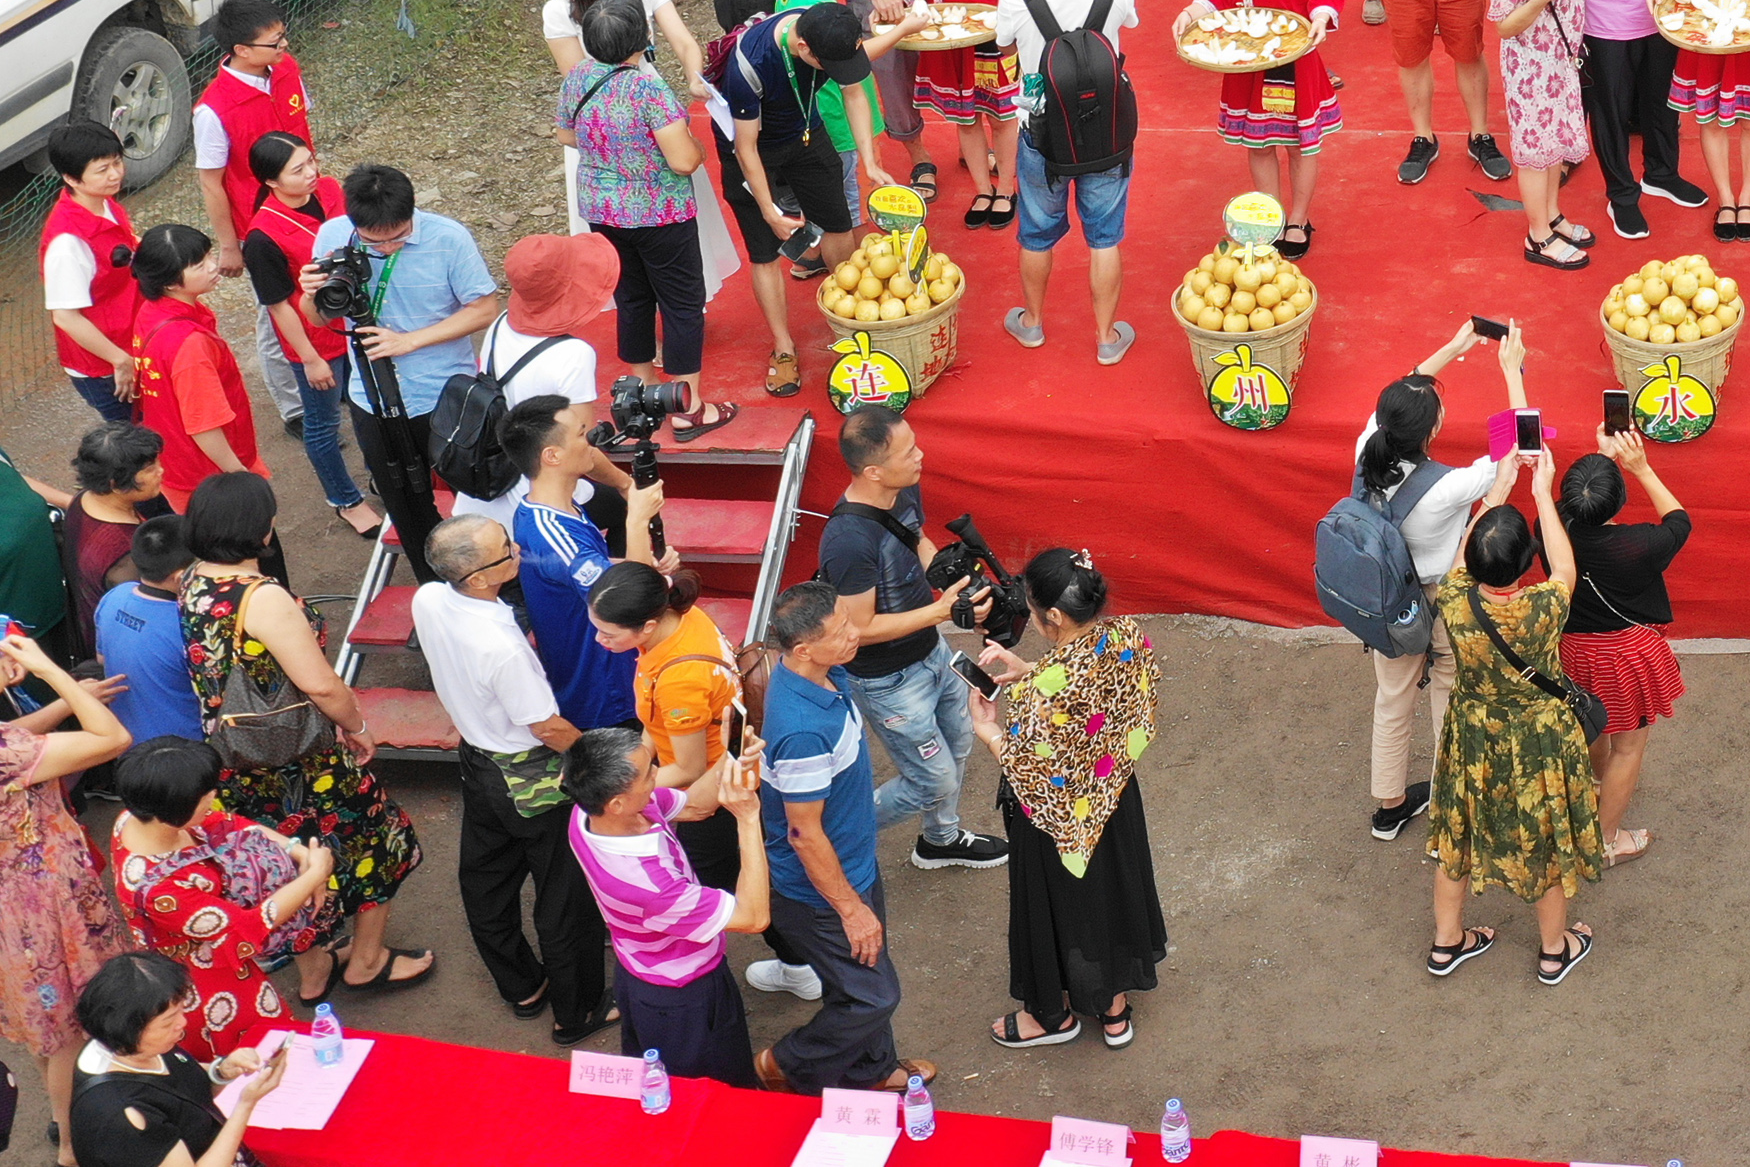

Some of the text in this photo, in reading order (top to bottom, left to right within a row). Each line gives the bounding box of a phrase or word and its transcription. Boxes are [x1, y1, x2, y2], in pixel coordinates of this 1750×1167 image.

[843, 362, 891, 406] 连
[1228, 373, 1270, 415] 州
[1650, 386, 1699, 426] 水
[579, 1063, 634, 1087] 冯艳萍
[1059, 1131, 1115, 1157] 傅学锋
